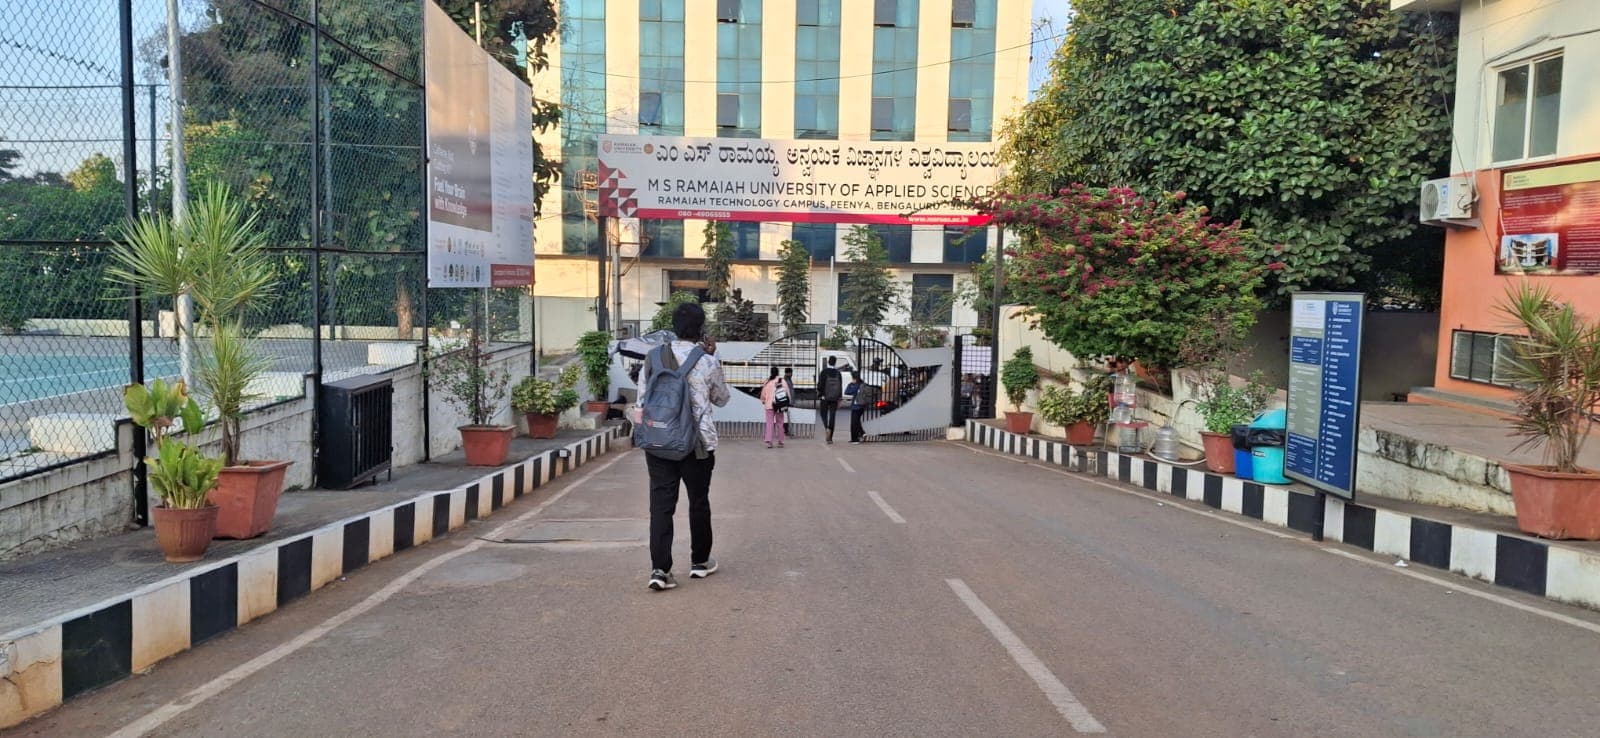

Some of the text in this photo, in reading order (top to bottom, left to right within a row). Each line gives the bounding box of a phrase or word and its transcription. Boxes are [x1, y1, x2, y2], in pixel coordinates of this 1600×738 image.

[656, 144, 678, 162] ಎಂ
[684, 142, 713, 163] ಎಸ್
[719, 142, 780, 177] ರಾಮಯ್ಯ
[787, 144, 840, 177] ಅನ್ವಯಿಕ
[846, 146, 903, 181] ವಿಜ್ಞಾನಗಳ
[648, 179, 659, 192] M
[663, 179, 672, 192] S
[676, 180, 745, 195] RAMAIAH
[750, 182, 836, 197] UNIVERSITY
[840, 183, 860, 197] OF
[865, 184, 927, 198] APPLIED
[658, 196, 706, 206] RAMAIAH
[709, 197, 779, 208] TECHNOLOGY
[783, 199, 829, 211] CAMPUS,
[830, 201, 874, 211] PEENYA,
[877, 201, 940, 210] BENGALURU
